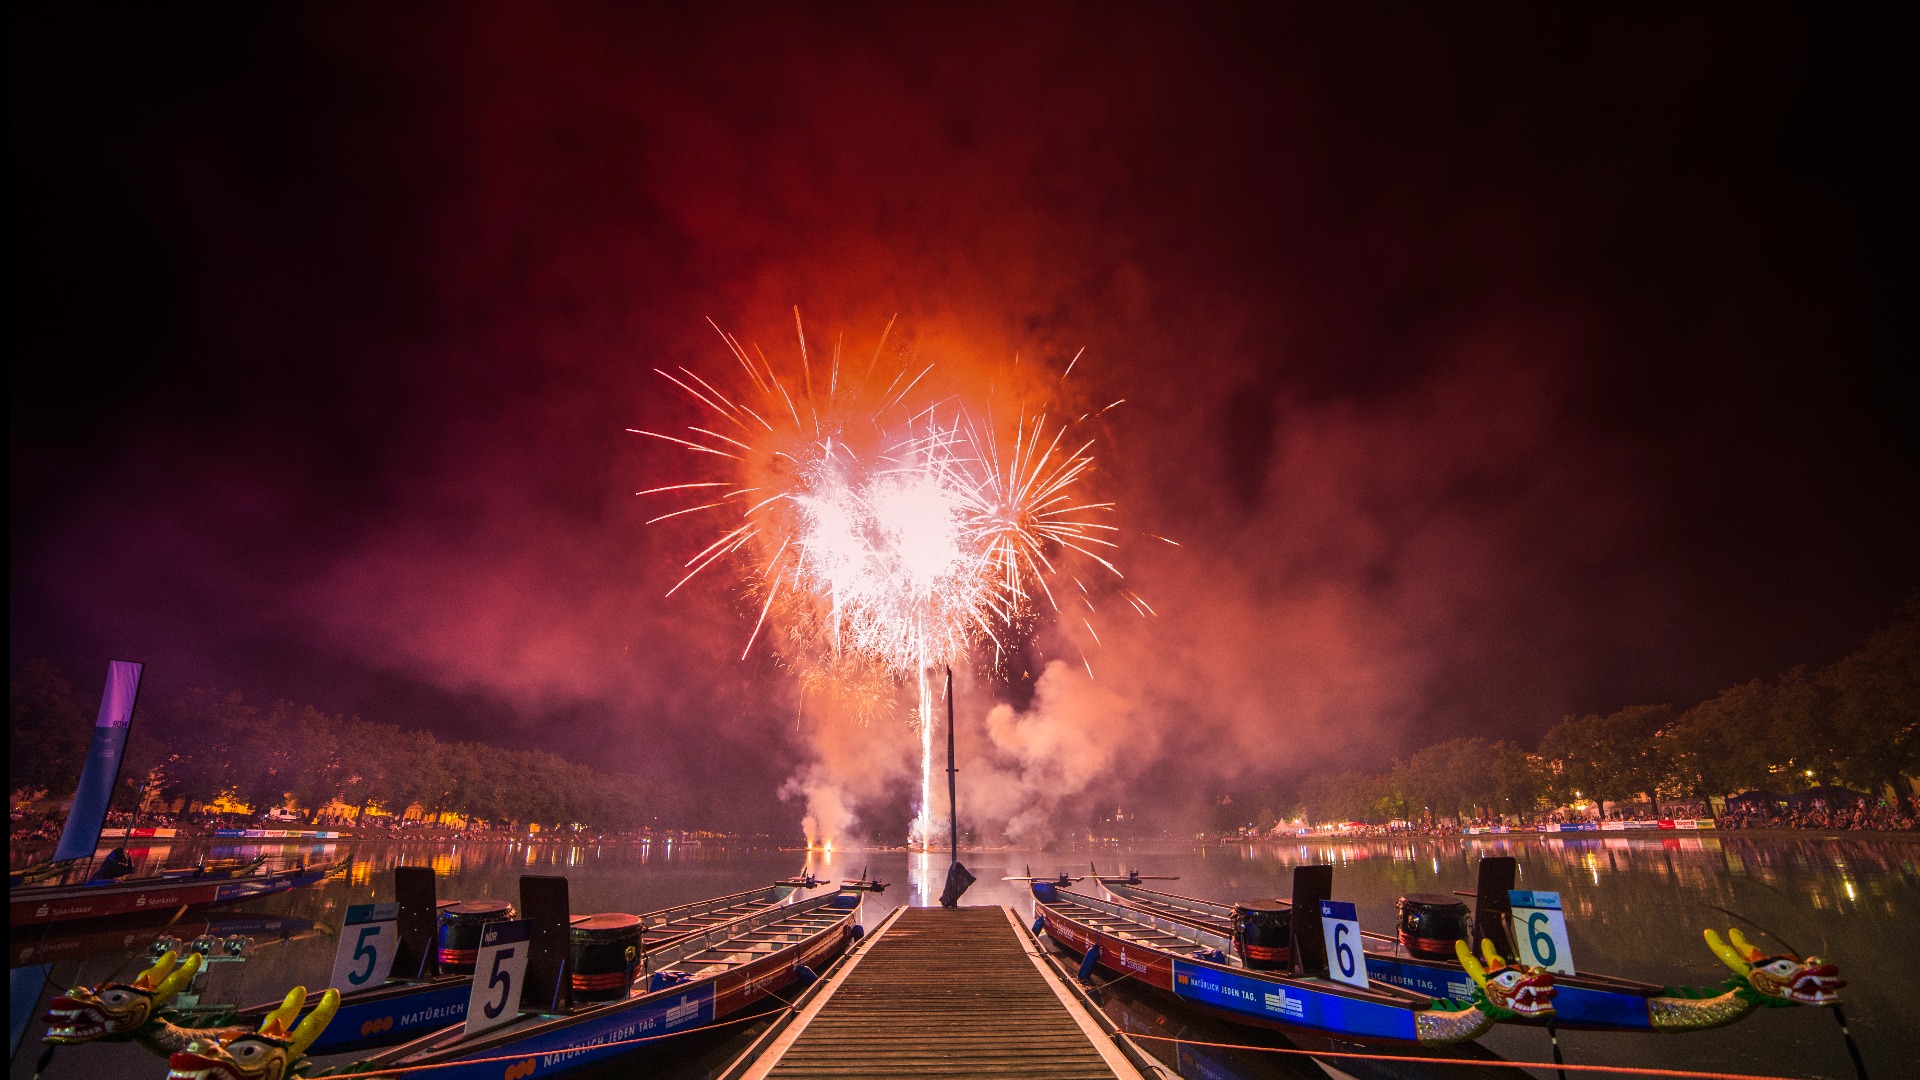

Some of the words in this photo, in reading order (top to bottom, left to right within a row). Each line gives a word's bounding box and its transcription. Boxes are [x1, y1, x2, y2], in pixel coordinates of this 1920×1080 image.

[52, 905, 92, 916] Sparkasse
[148, 896, 179, 906] Sparkasse
[484, 930, 499, 943] NDR
[1528, 911, 1557, 967] 6
[348, 926, 382, 985] 5
[1334, 922, 1356, 978] 6
[483, 947, 516, 1020] 5
[1190, 978, 1220, 992] NATÜRLICH
[1221, 985, 1240, 998] JEDEN
[1241, 990, 1257, 1002] TAG.
[1389, 975, 1414, 986] JEDEN
[1416, 979, 1437, 991] TAG.
[400, 1003, 464, 1026] NATÜRLICH
[543, 1036, 604, 1068] NATÜRLICH
[608, 1026, 635, 1044] JEDEN
[638, 1018, 657, 1032] TAG.
